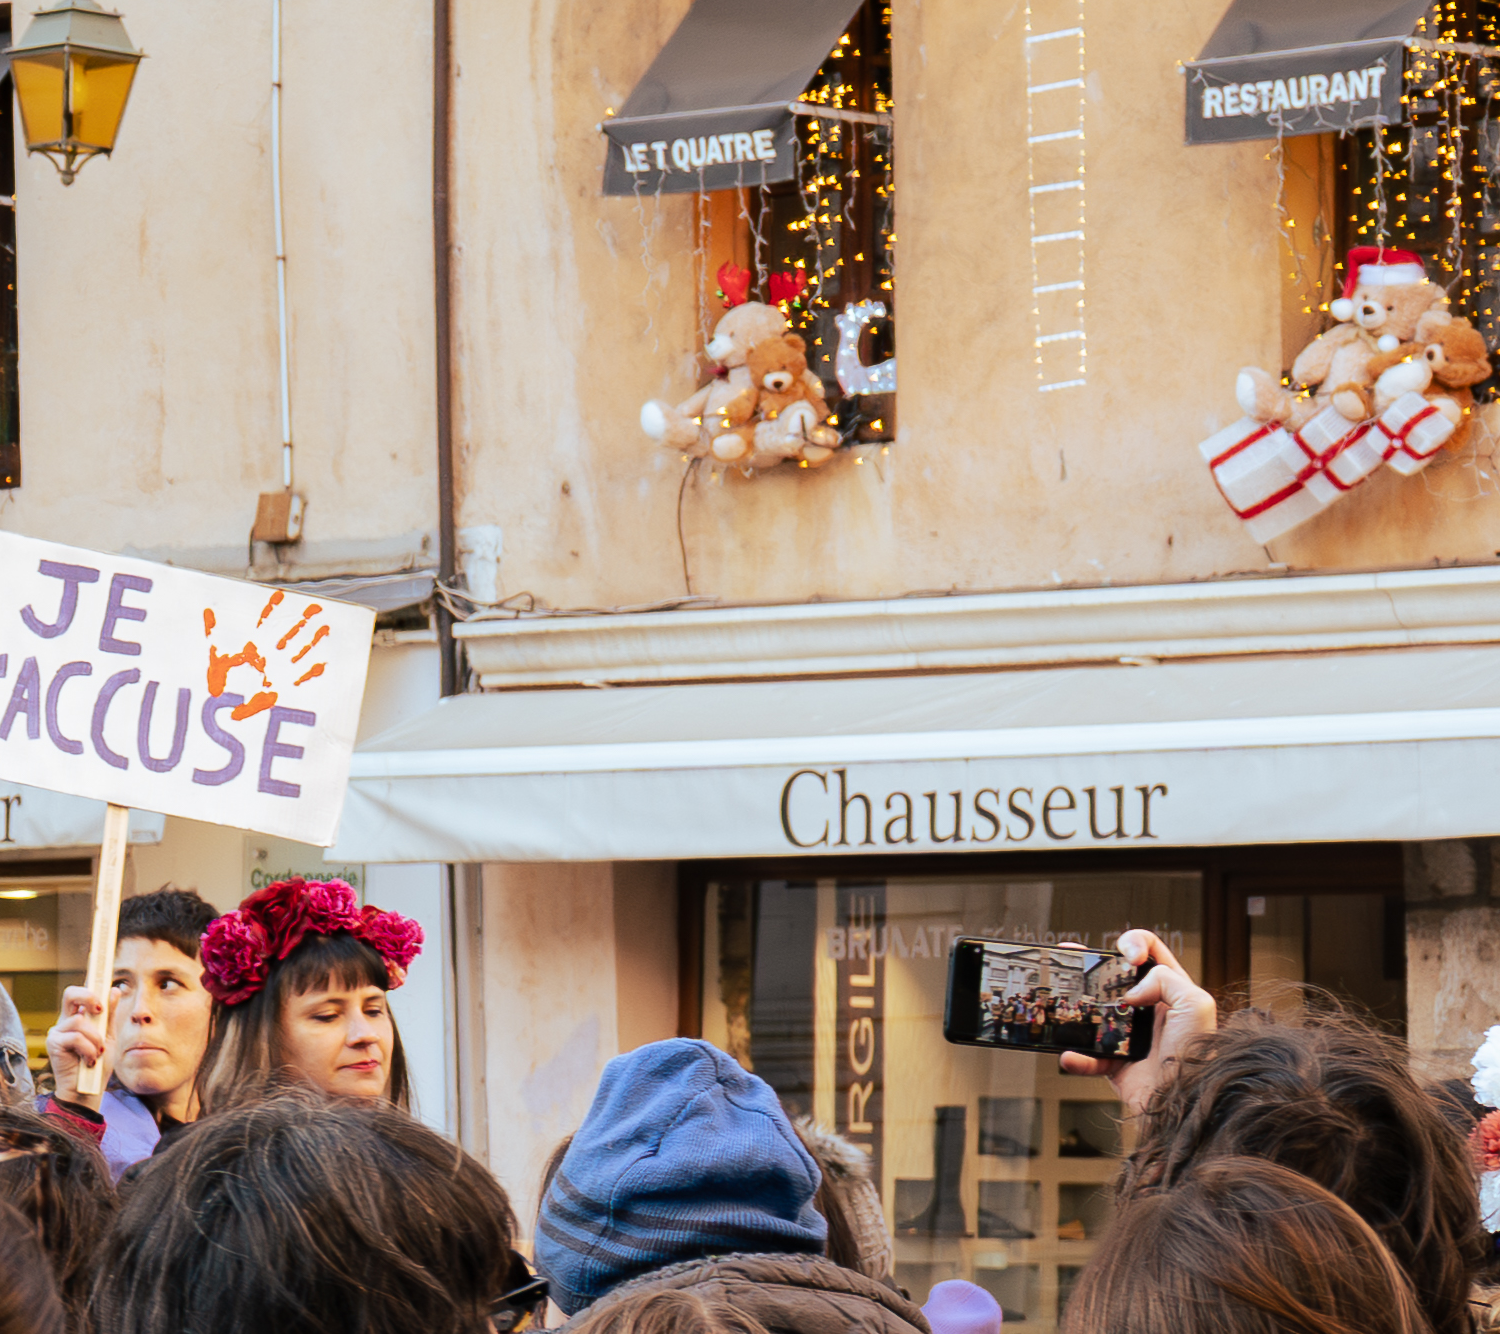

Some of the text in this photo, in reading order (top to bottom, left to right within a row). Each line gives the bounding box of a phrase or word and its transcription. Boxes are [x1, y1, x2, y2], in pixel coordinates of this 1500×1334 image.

[1202, 65, 1387, 120] RESTAURANT
[670, 128, 777, 173] QUATRE
[19, 558, 155, 657] JE
[779, 766, 1169, 849] Chausseur
